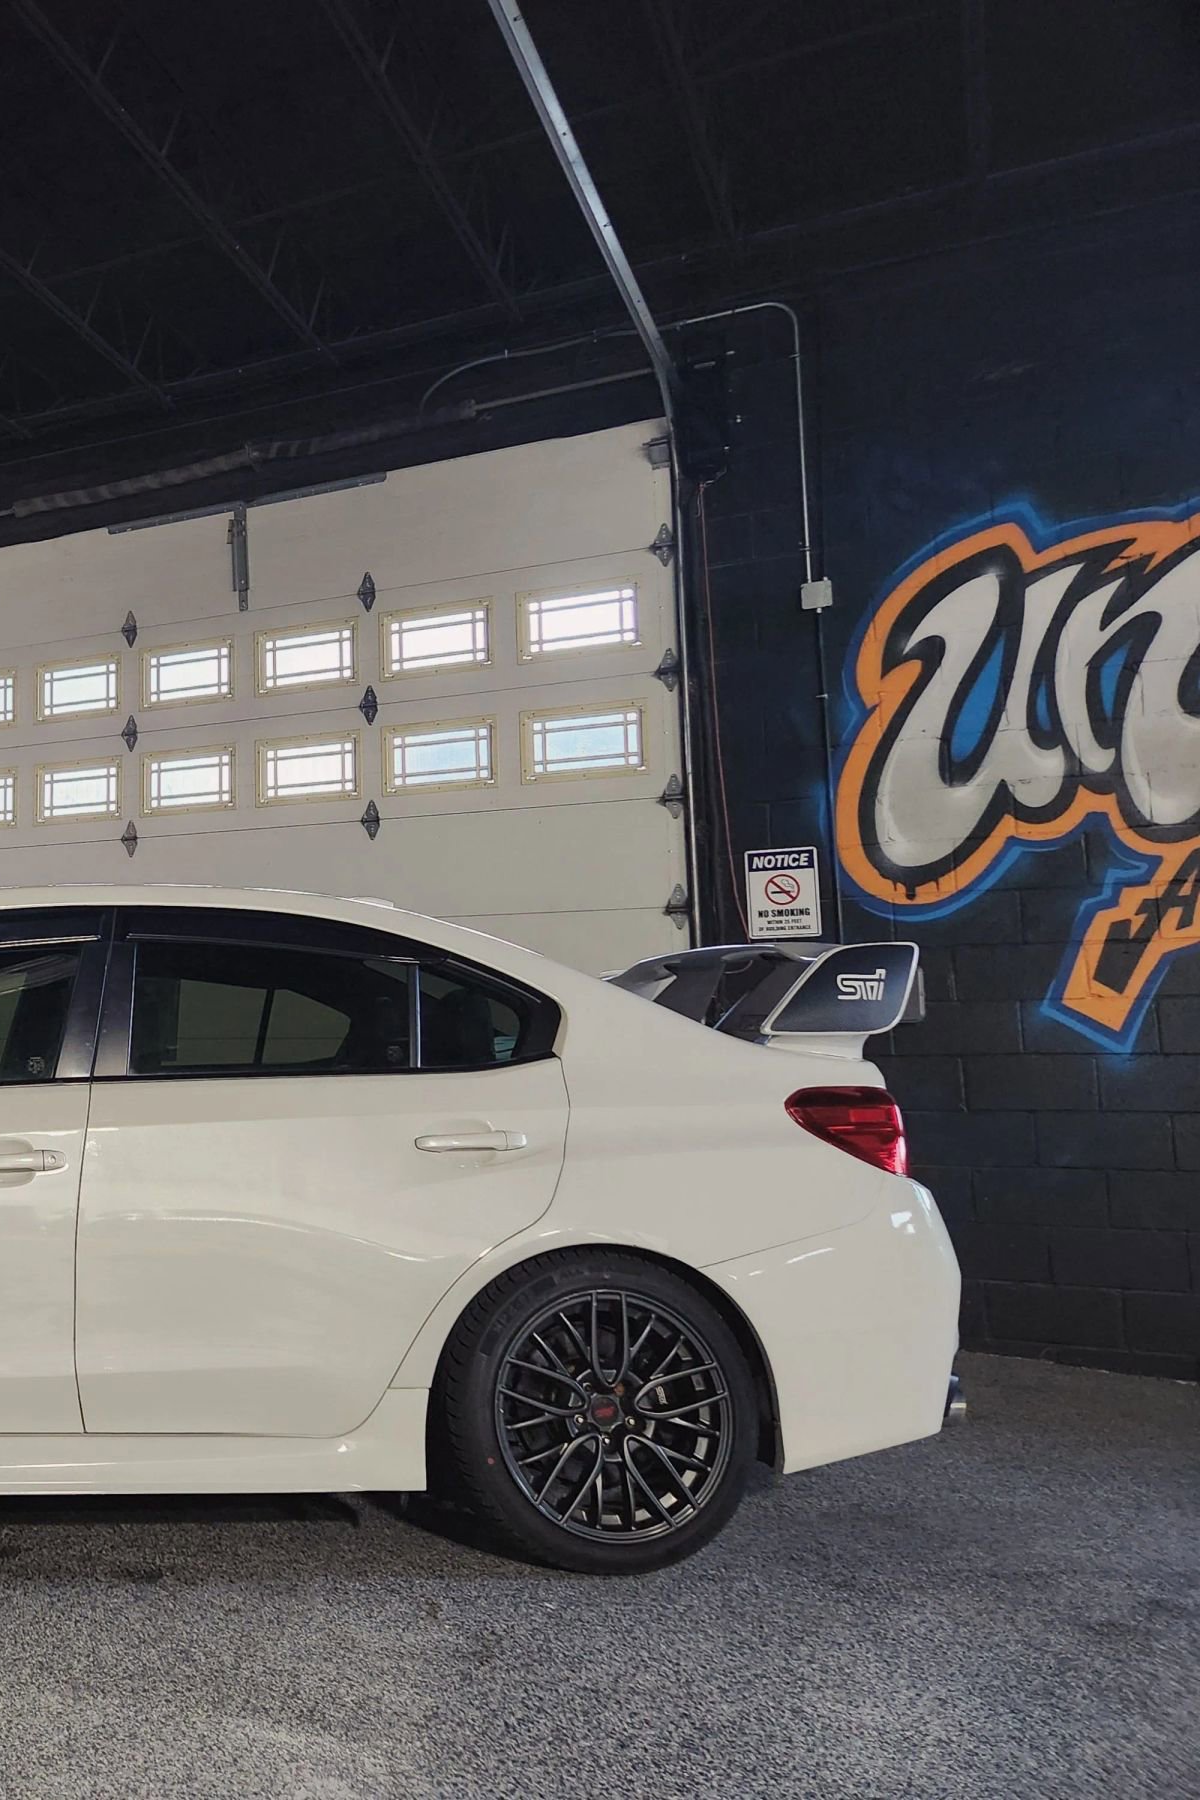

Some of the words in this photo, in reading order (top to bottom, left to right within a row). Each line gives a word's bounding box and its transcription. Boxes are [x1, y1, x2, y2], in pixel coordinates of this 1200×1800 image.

[752, 853, 810, 870] NOTICE
[758, 910, 770, 918] NO
[771, 908, 811, 918] SMOKING
